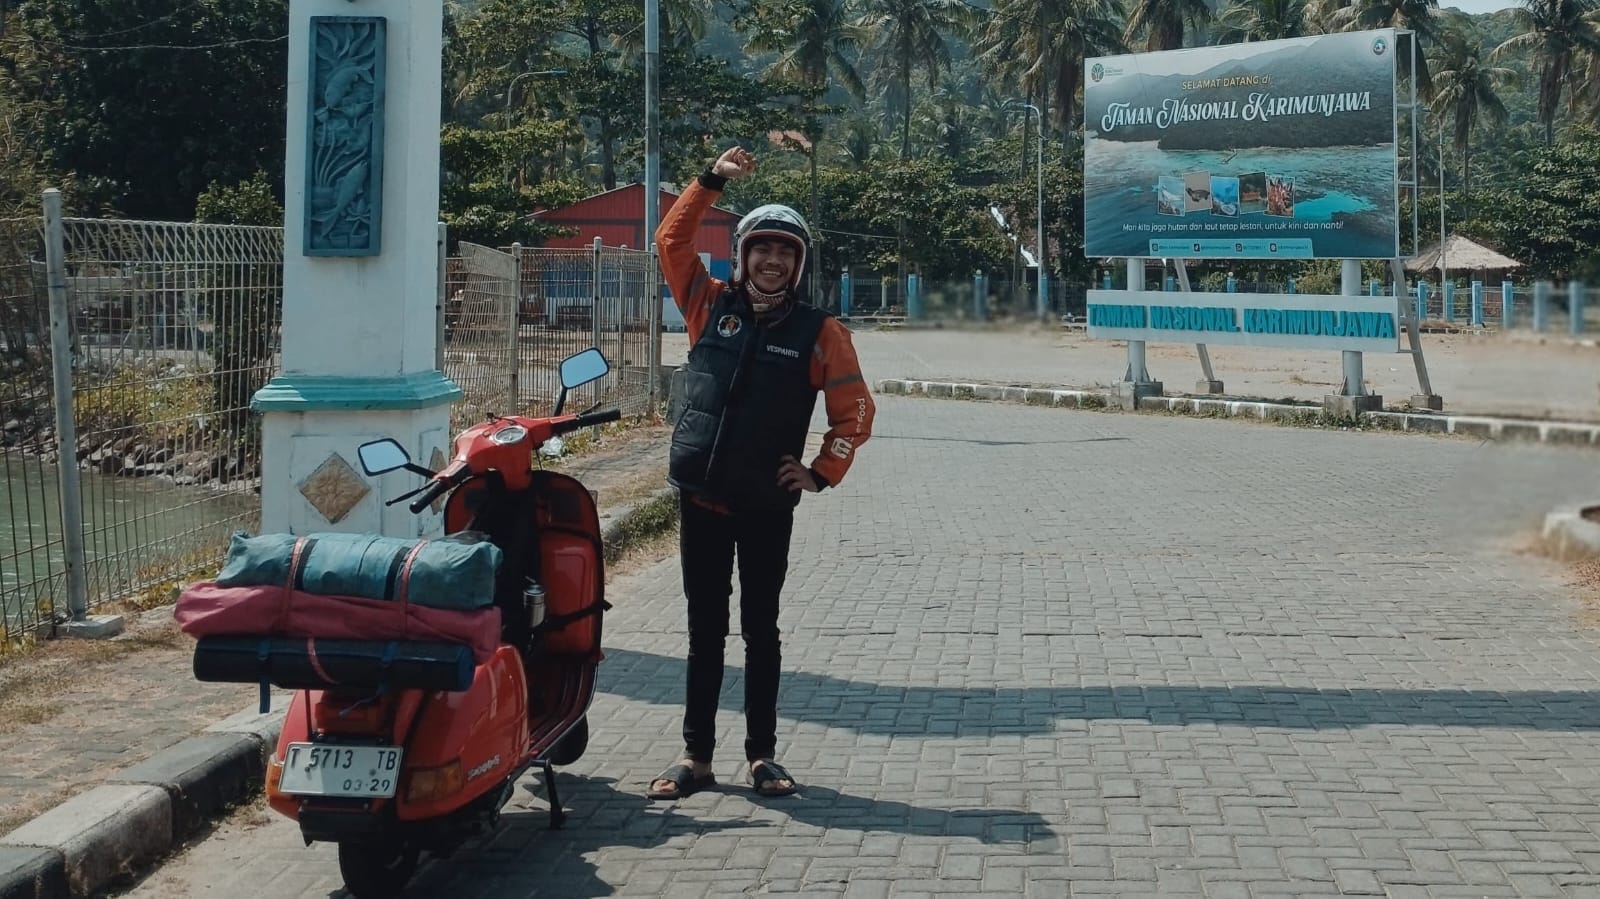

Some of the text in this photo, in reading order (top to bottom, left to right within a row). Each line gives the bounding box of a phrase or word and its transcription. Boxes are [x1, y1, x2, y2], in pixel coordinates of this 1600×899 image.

[1182, 74, 1272, 90] SELAMAT DATANG di
[1101, 91, 1371, 132] TAMAN NASIONAL KARIMUNJAWA
[1138, 223, 1150, 231] kita
[1150, 223, 1167, 232] jaga
[1168, 223, 1188, 231] hutan
[1189, 222, 1203, 231] dan
[1204, 222, 1218, 231] laut
[1219, 222, 1239, 232] tetap
[1265, 222, 1287, 230] untuk
[1288, 221, 1303, 230] kini
[1303, 221, 1319, 230] dan
[1320, 221, 1344, 230] nanti!
[1088, 304, 1397, 338] TAMAN NASIONAL KARIMUNJAWA
[291, 747, 398, 771] T 5713 TB
